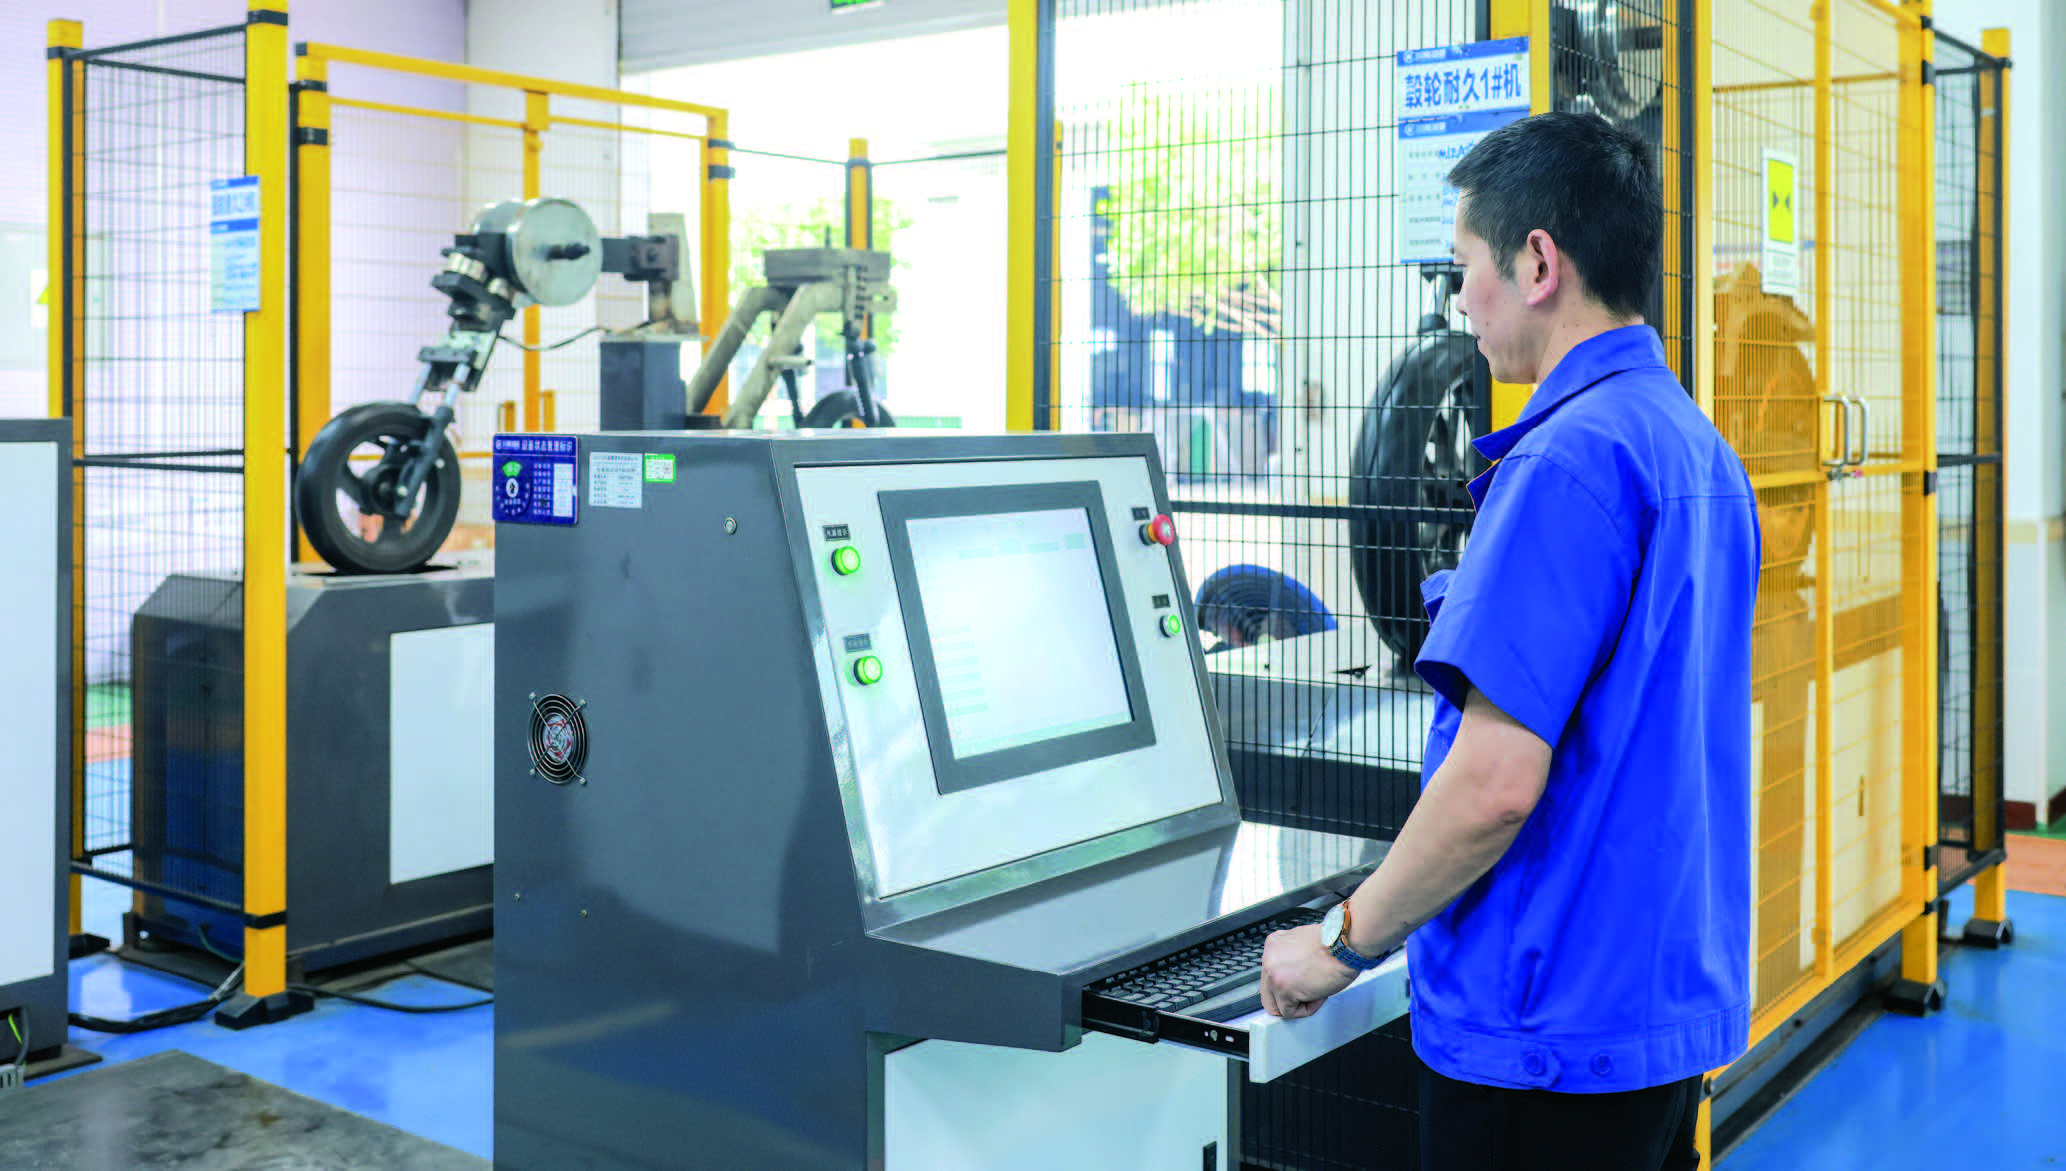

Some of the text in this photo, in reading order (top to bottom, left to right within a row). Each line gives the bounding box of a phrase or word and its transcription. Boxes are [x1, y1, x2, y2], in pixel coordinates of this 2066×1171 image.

[522, 440, 573, 452] 设备状态管理标识
